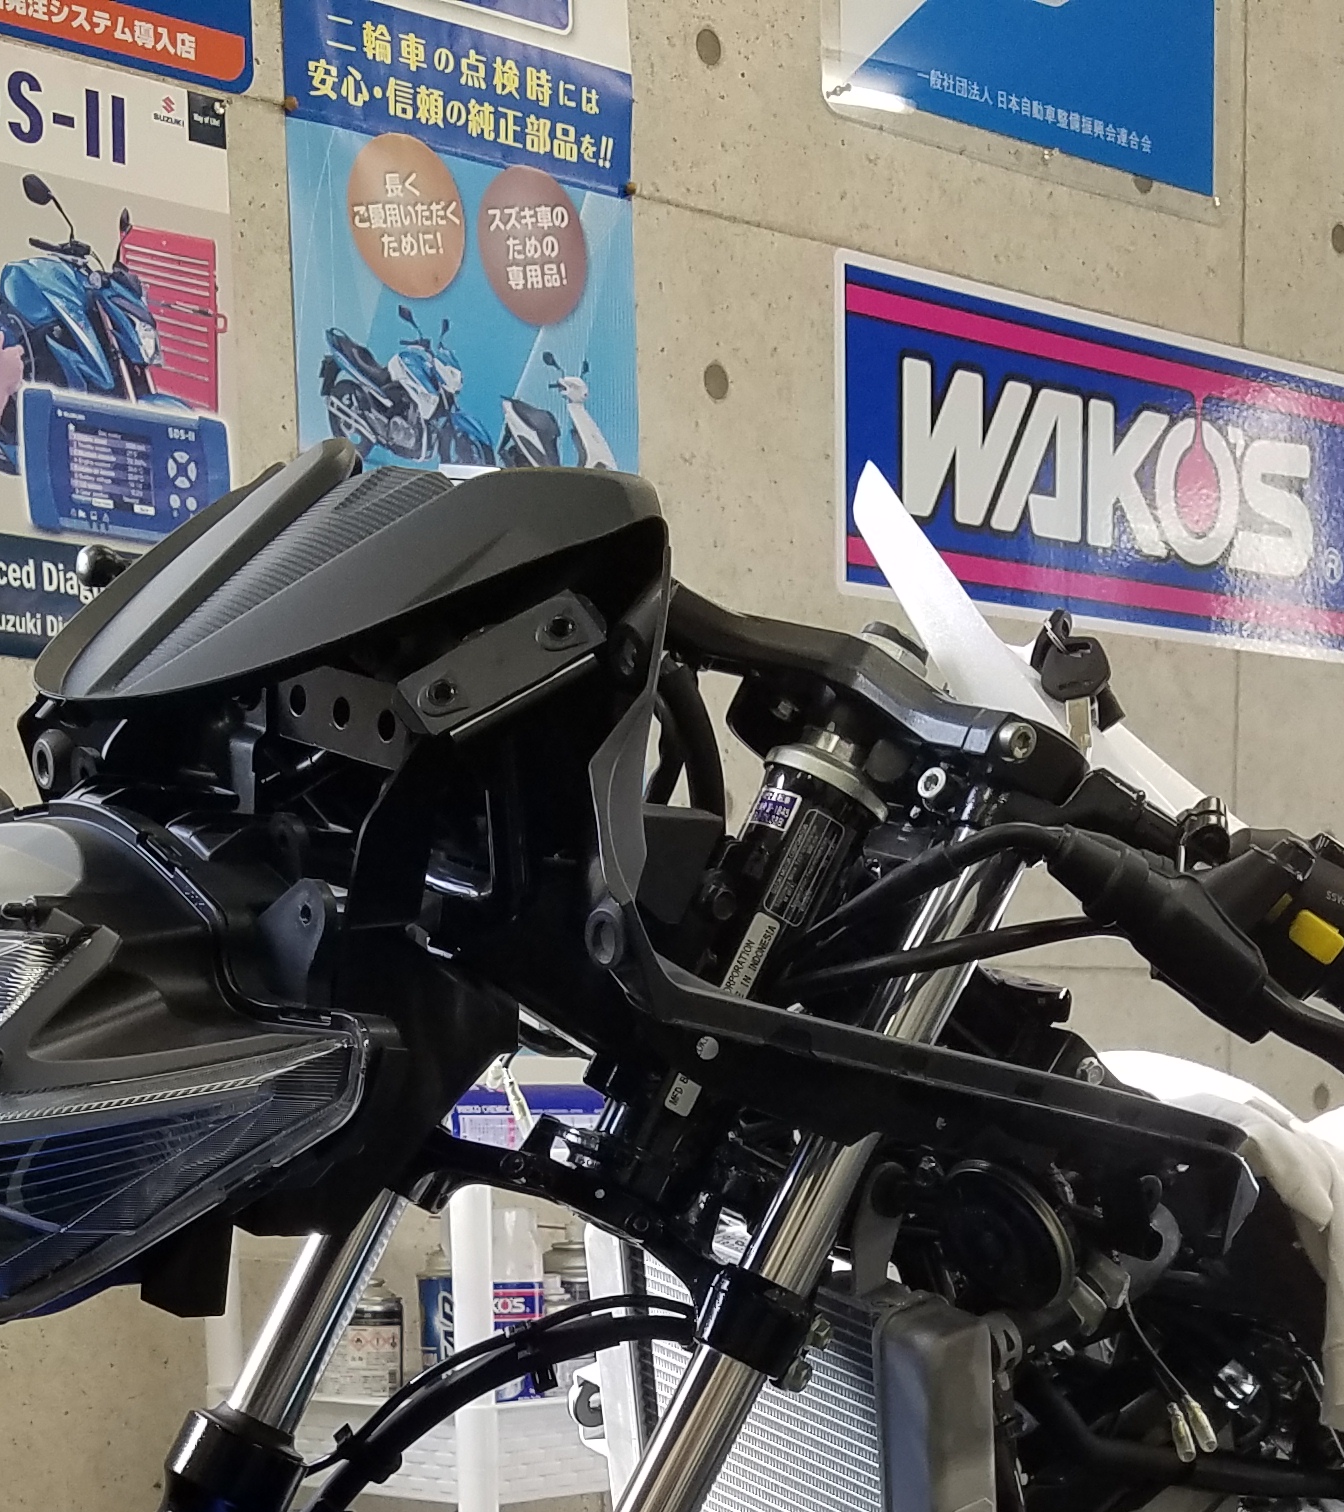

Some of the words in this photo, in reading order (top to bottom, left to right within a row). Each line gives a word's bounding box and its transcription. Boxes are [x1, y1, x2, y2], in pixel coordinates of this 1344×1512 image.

[326, 14, 600, 115] 二輪車の点検時には
[917, 69, 994, 106] 一般社団法人
[153, 112, 185, 128] SUZUKI
[385, 172, 420, 198] 長く
[353, 200, 461, 229] ご愛用いただく
[487, 205, 569, 232] スズキ車の
[380, 232, 444, 258] ために!
[506, 235, 559, 260] ための
[901, 355, 1314, 579] WAKO'S
